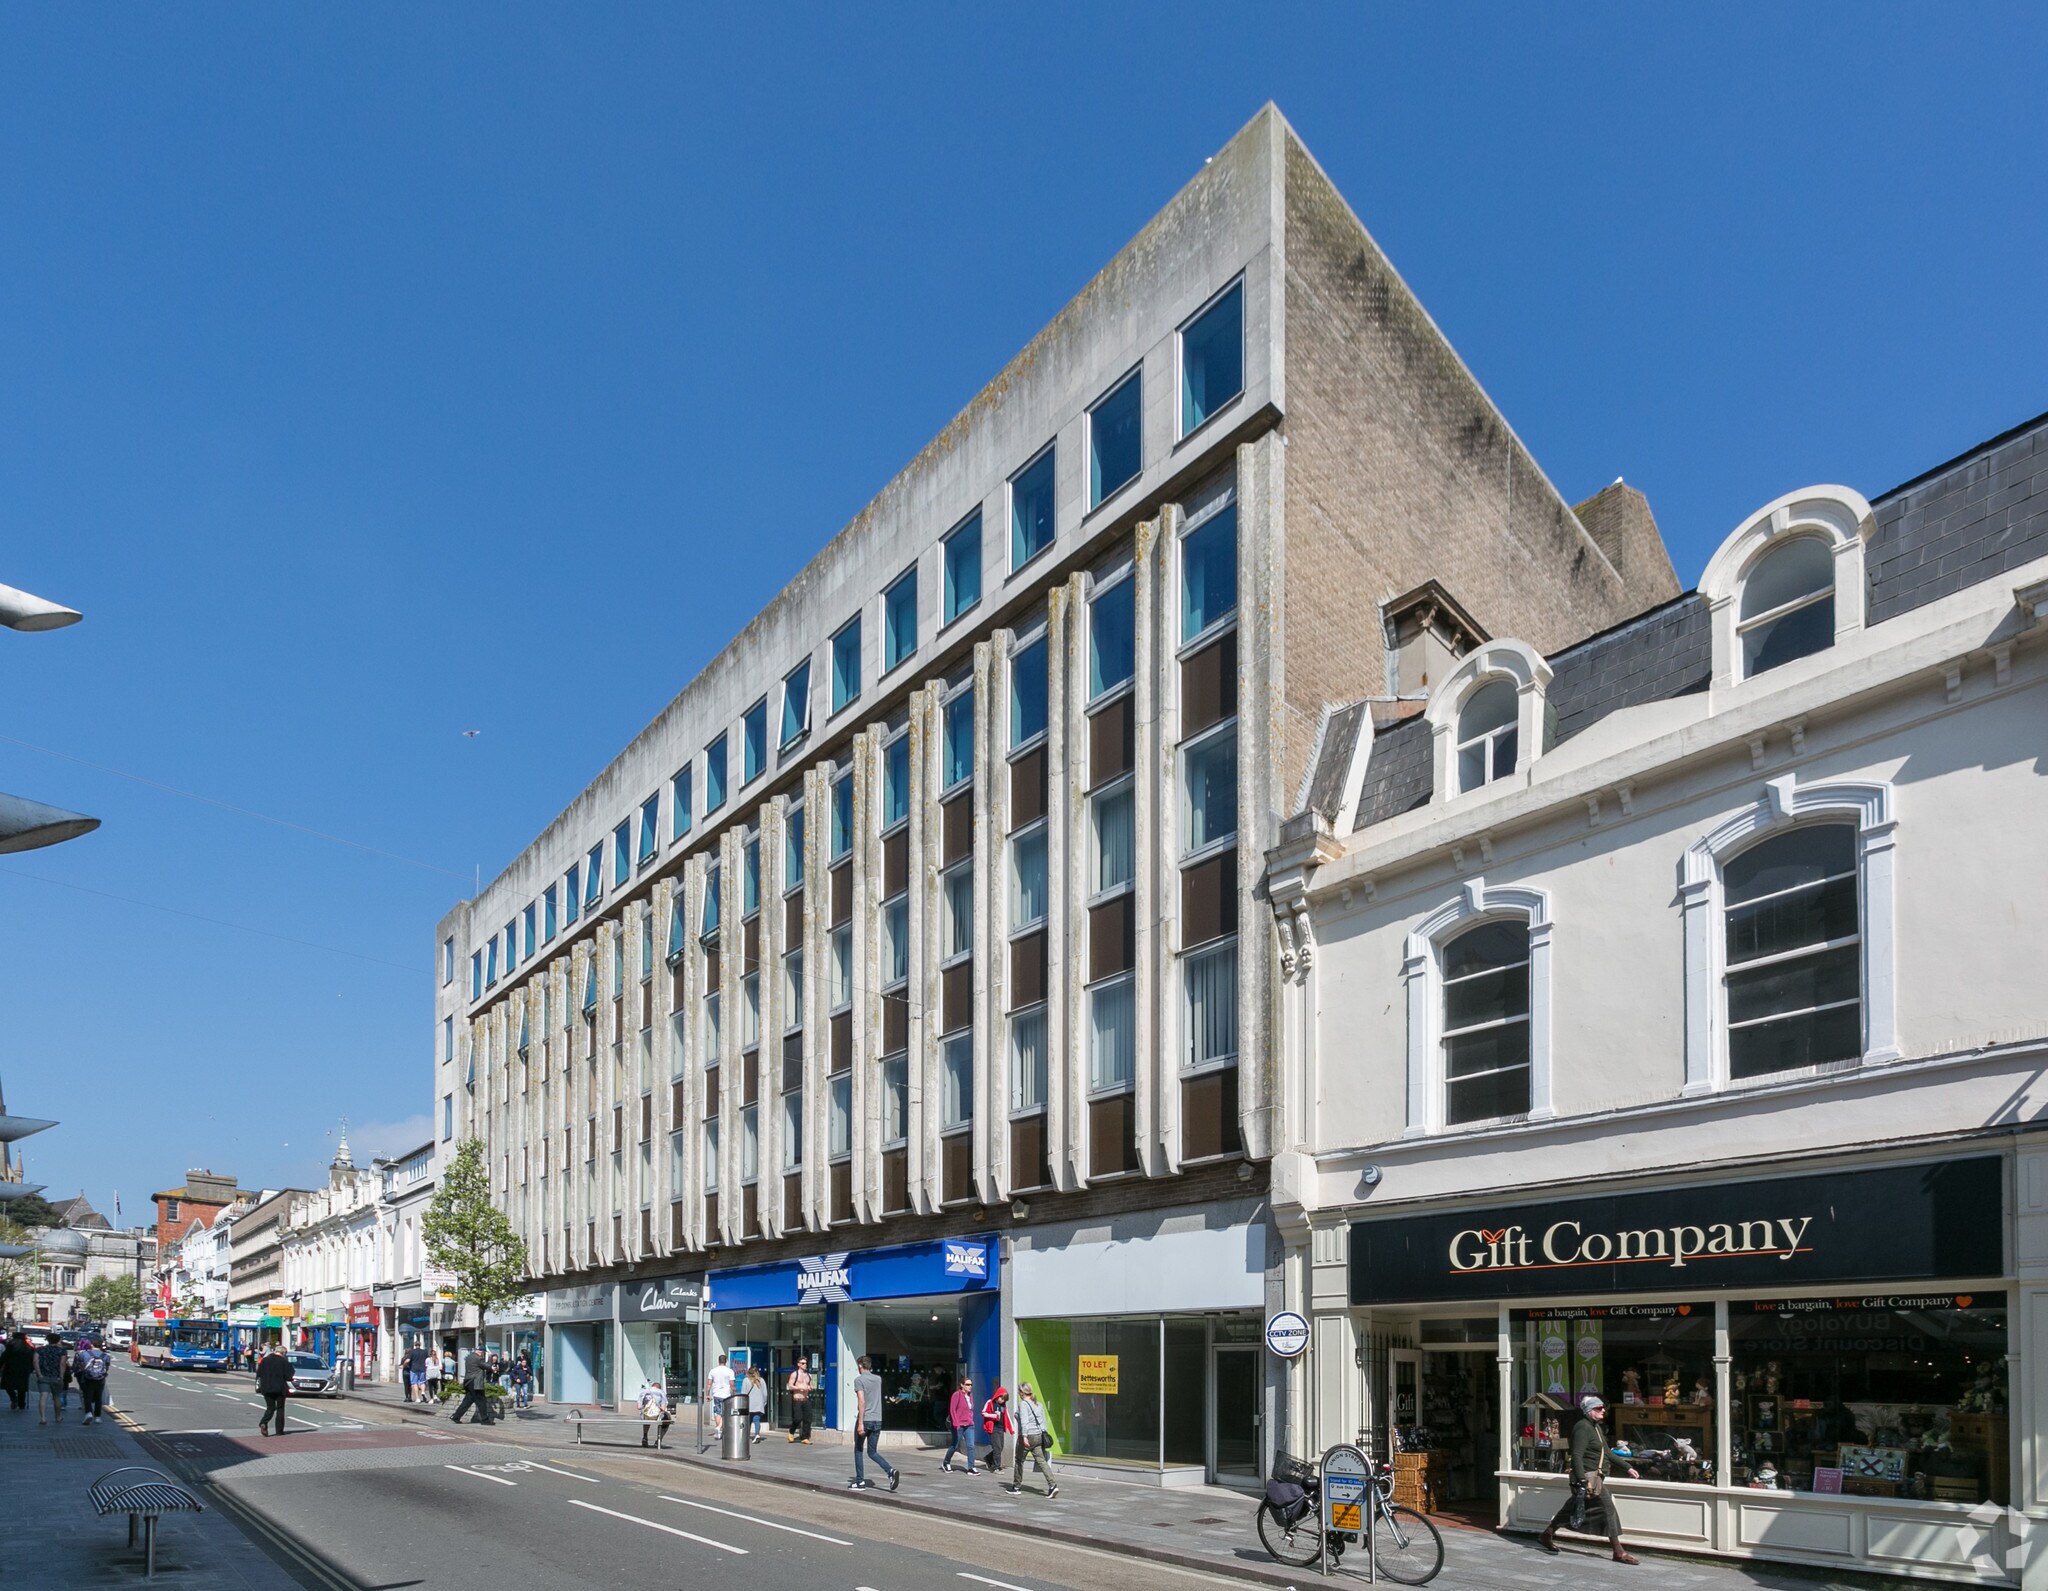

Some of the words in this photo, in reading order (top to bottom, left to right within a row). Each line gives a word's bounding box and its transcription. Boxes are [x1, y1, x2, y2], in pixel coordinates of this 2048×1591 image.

[1449, 1225, 1534, 1270] Gift
[1542, 1216, 1813, 1268] Company
[946, 1253, 985, 1266] HALIFAX
[797, 1268, 850, 1290] HALIFAX
[670, 1287, 698, 1297] Clarks
[588, 1297, 605, 1307] CENTRE
[1754, 1301, 1776, 1311] love
[1787, 1300, 1833, 1312] bargain,
[1835, 1299, 1860, 1309] love
[1862, 1297, 1886, 1308] Gift
[1888, 1296, 1953, 1309] Company
[1528, 1309, 1546, 1318] love
[1554, 1308, 1589, 1319] bargain,
[1590, 1307, 1609, 1316] love
[1610, 1306, 1628, 1316] Gift
[1629, 1305, 1677, 1318] Company
[1094, 1361, 1108, 1369] LET
[1080, 1374, 1116, 1383] Bettesworths
[1397, 1393, 1414, 1411] Gift
[1329, 1453, 1344, 1466] UNION
[1344, 1453, 1362, 1467] STREET
